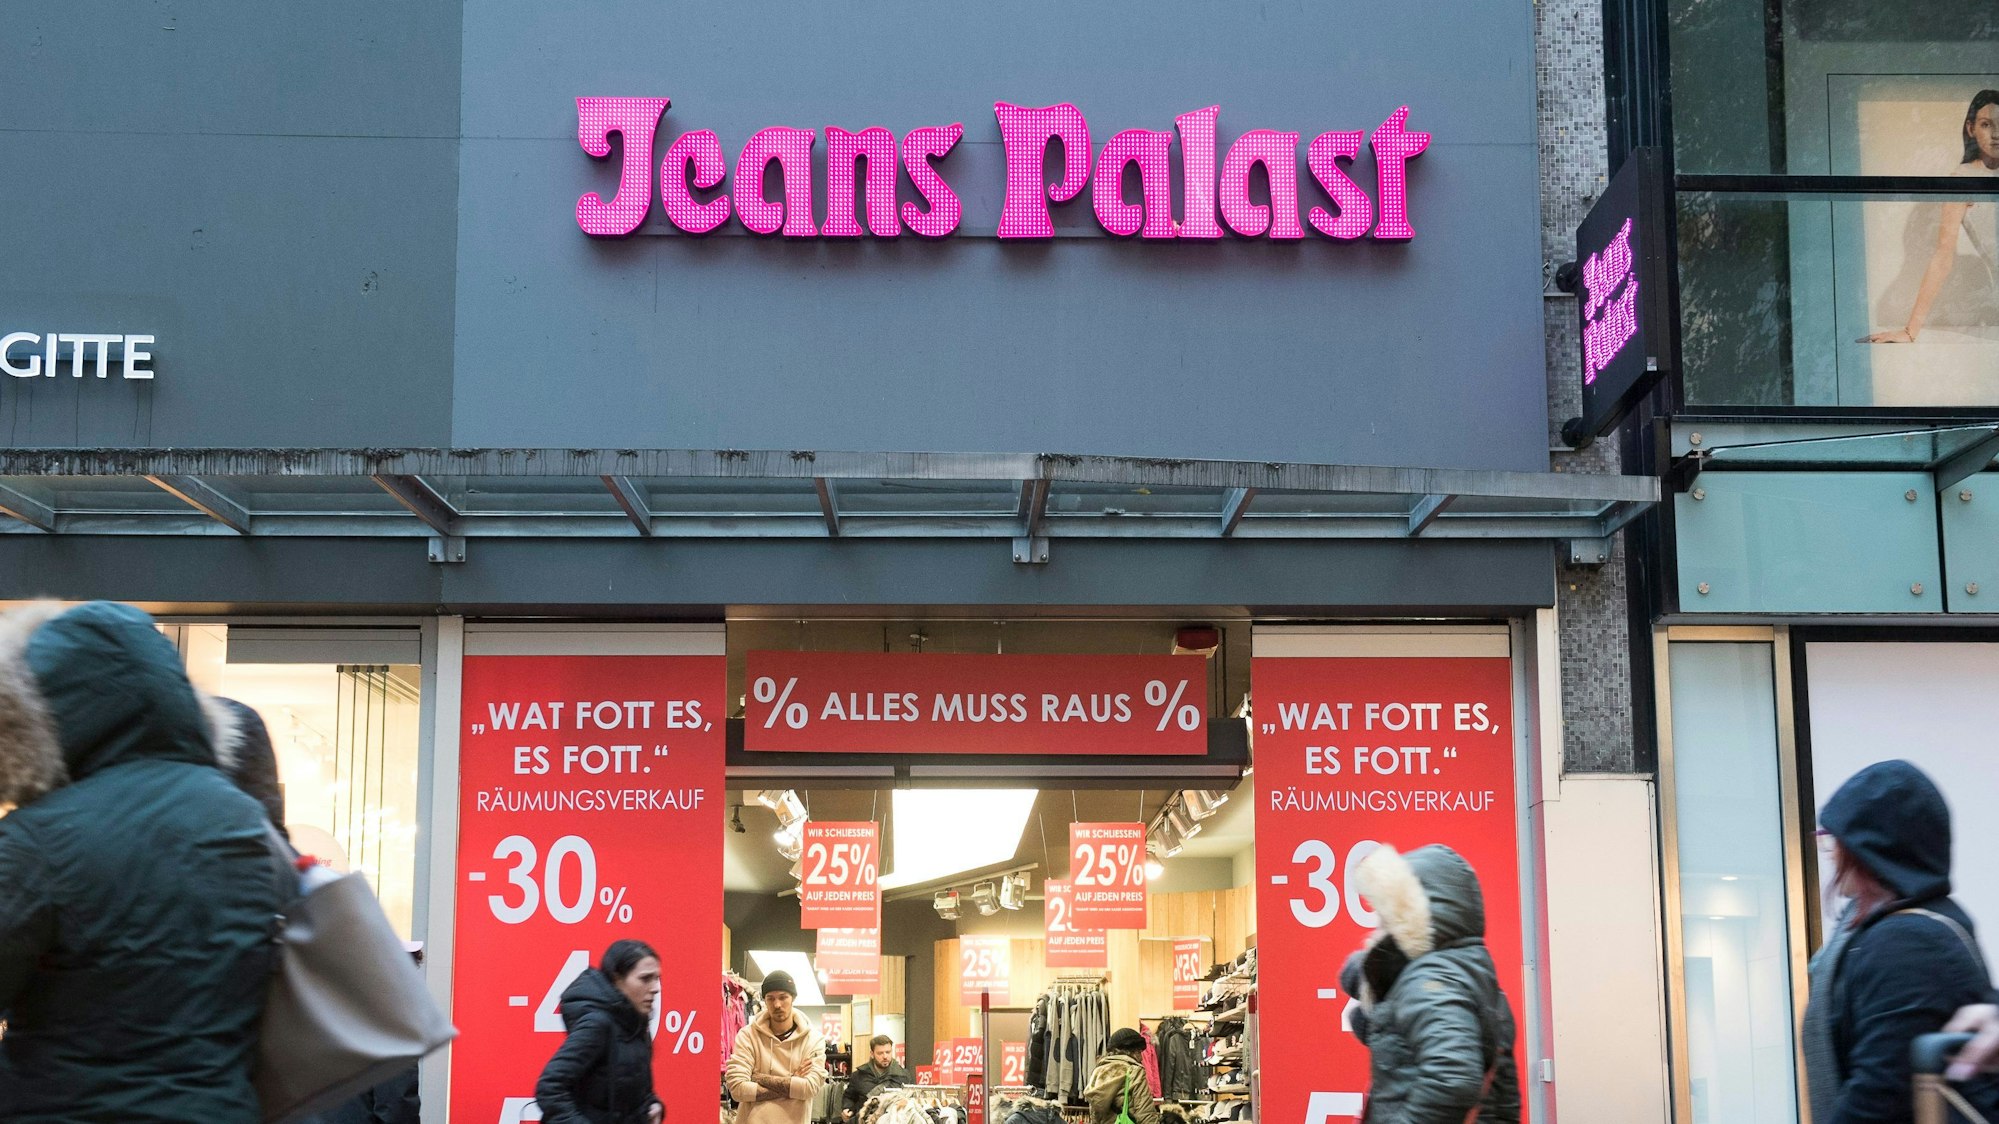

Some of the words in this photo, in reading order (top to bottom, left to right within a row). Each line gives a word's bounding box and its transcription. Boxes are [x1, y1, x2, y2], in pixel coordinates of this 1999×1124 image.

[576, 96, 963, 238] Jeans
[994, 101, 1432, 240] Palast
[0, 332, 155, 379] GITTE
[576, 701, 655, 730] FOTT
[667, 700, 712, 733] ES,
[820, 692, 919, 722] ALLES
[931, 693, 1027, 723] MUSS
[1042, 694, 1132, 723] RAUS
[1365, 702, 1442, 731] FOTT
[1454, 702, 1500, 735] ES,
[514, 746, 550, 775] ES
[1306, 747, 1341, 775] ES
[477, 787, 704, 812] RÄUMUNGSVERKAUF
[1271, 787, 1495, 812] RÄUMUNGSVERKAUF
[808, 828, 823, 838] WIR
[825, 828, 875, 838] SCHLIESSEN!
[1075, 829, 1090, 838] WIR
[1092, 829, 1141, 838] SCHLIESSEN!
[806, 843, 876, 886] 25%
[1074, 843, 1144, 887] 25%
[806, 891, 823, 901] AUF
[824, 891, 850, 901] JEDEN
[852, 891, 874, 901] PREIS
[1075, 891, 1092, 901] AUF
[1093, 891, 1119, 901] JEDEN
[1121, 892, 1143, 902] PREIS
